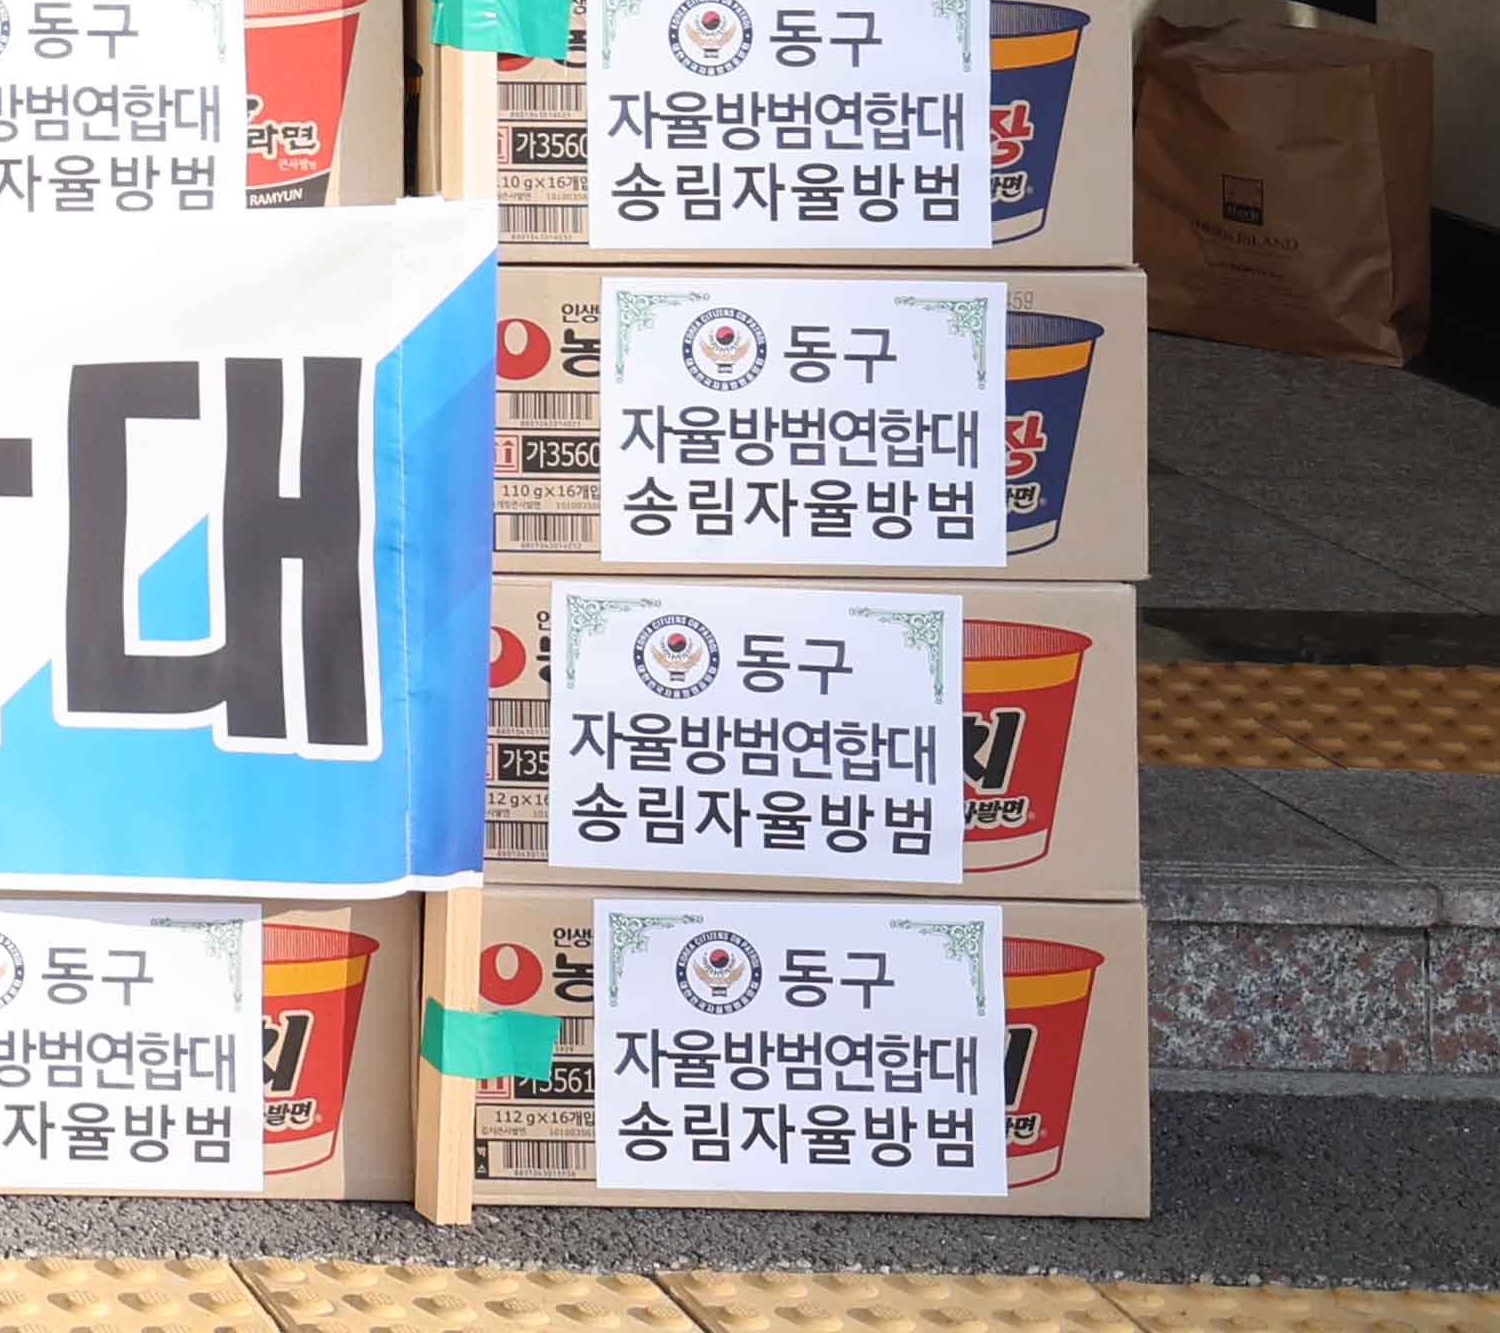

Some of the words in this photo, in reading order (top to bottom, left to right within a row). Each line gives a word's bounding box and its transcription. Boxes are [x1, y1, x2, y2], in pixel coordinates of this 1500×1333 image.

[27, 1, 139, 60] 동구
[769, 9, 883, 69] 동구
[607, 91, 965, 152] 자율방범연합대
[250, 187, 303, 208] RAMYUN
[611, 161, 960, 222] 송림자율방범
[783, 325, 897, 384] 동구
[620, 406, 977, 469] 자율방범연합대
[623, 477, 975, 540] 송림자율방범
[736, 633, 853, 695] 동구
[570, 710, 937, 785] 자율방범연합대
[571, 781, 931, 855] 송림자율방범
[42, 947, 155, 1007] 동구
[779, 949, 896, 1009] 동구
[615, 1029, 978, 1095] 자율방범연합대
[617, 1100, 975, 1168] 송림자율방범
